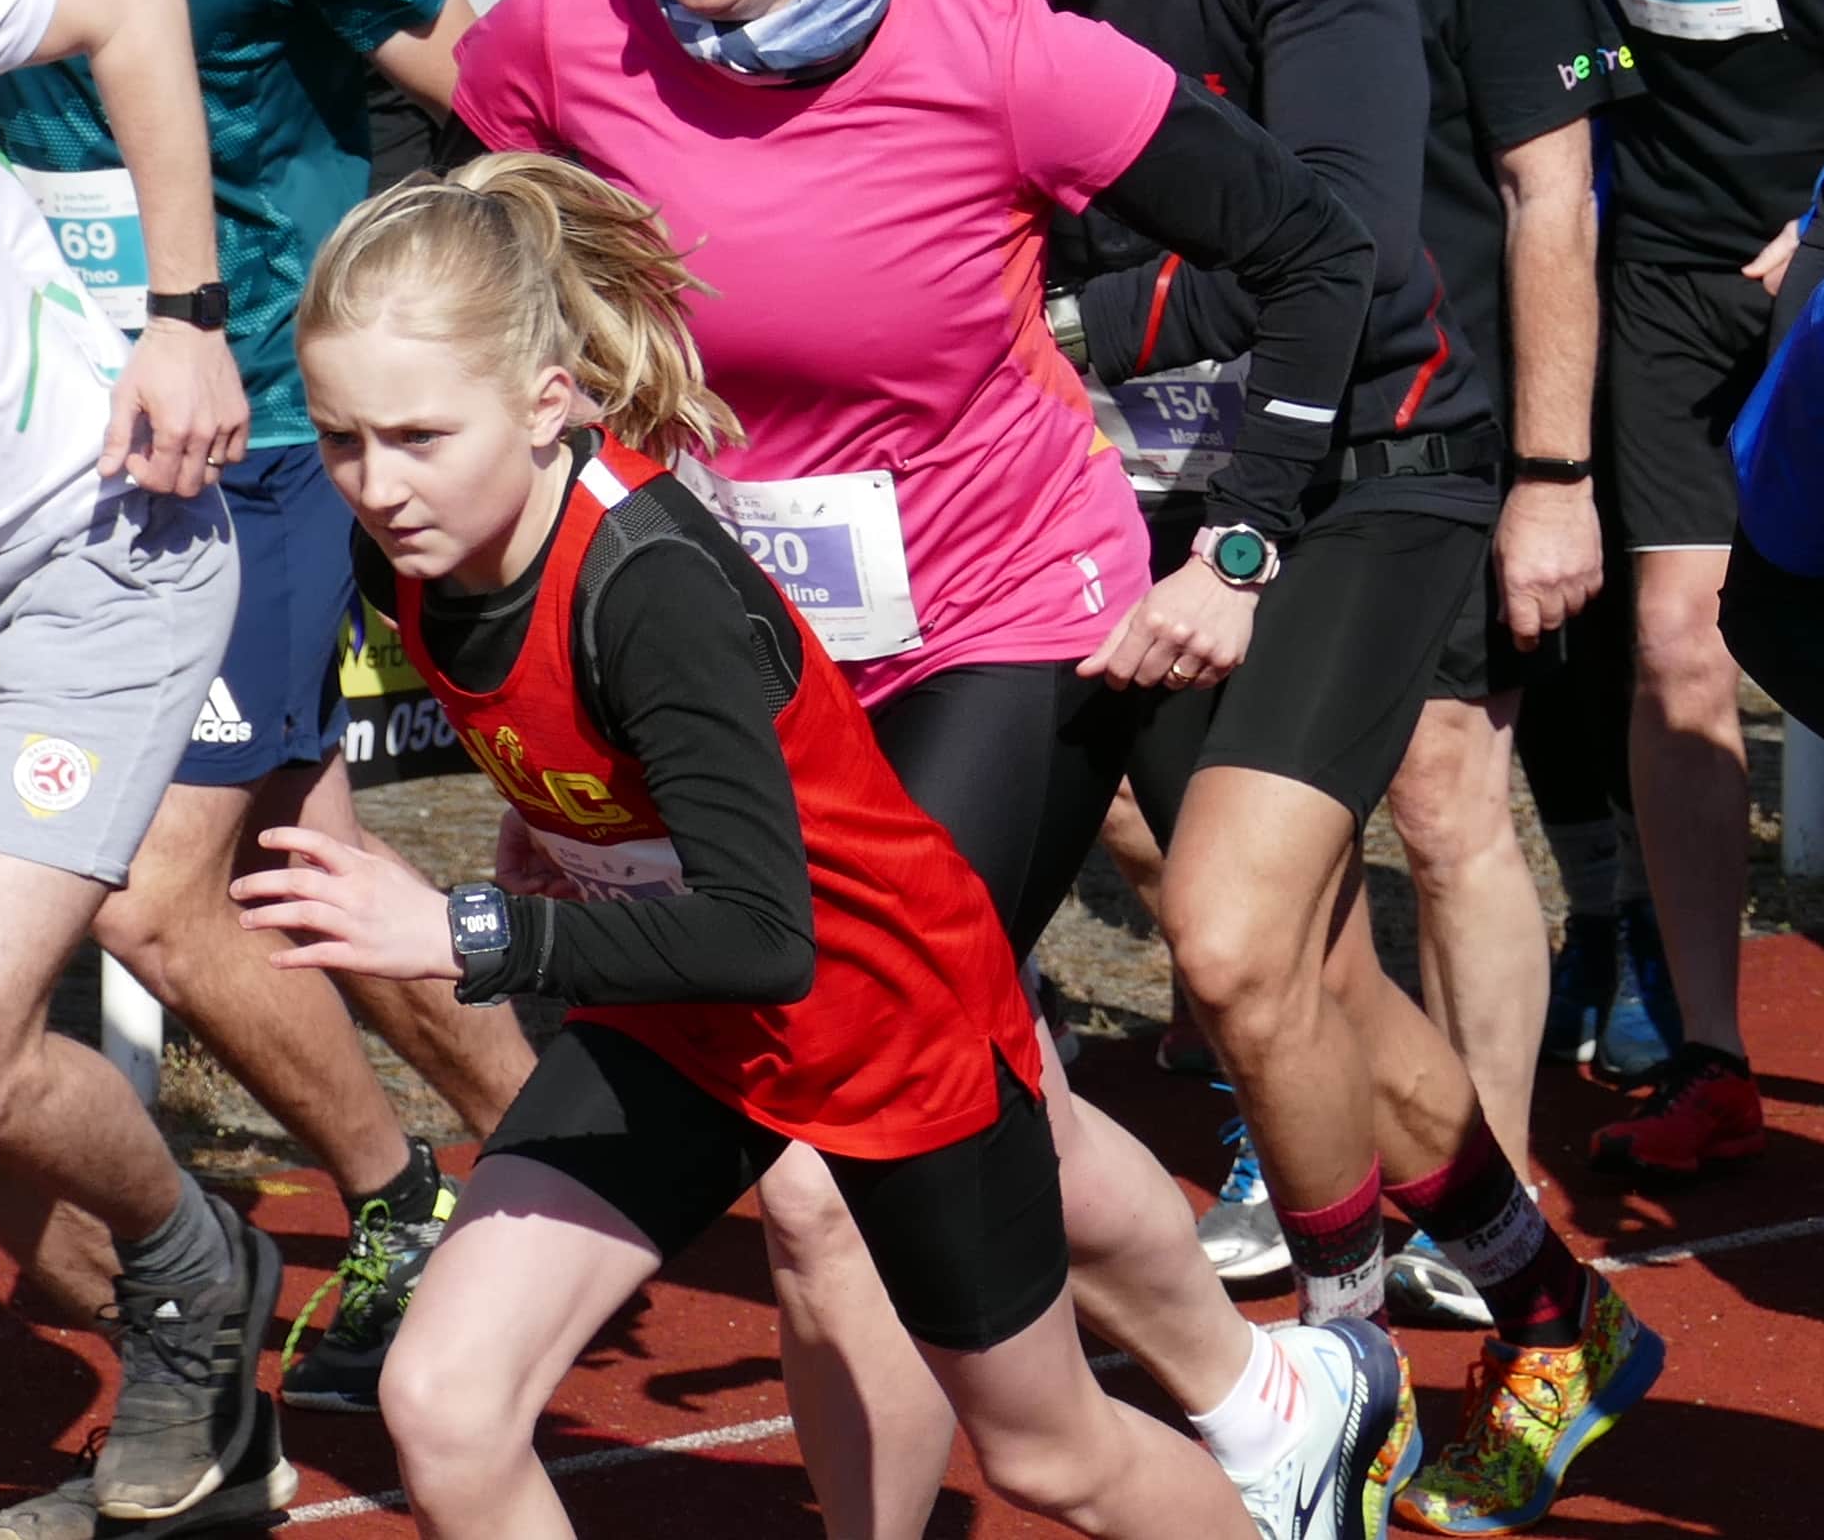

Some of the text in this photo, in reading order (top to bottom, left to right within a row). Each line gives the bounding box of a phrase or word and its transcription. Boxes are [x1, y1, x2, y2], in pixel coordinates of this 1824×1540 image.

[60, 221, 118, 261] 69
[1142, 385, 1220, 422] 154
[1168, 427, 1224, 446] Marcel
[719, 521, 809, 576] 20
[783, 583, 830, 603] line
